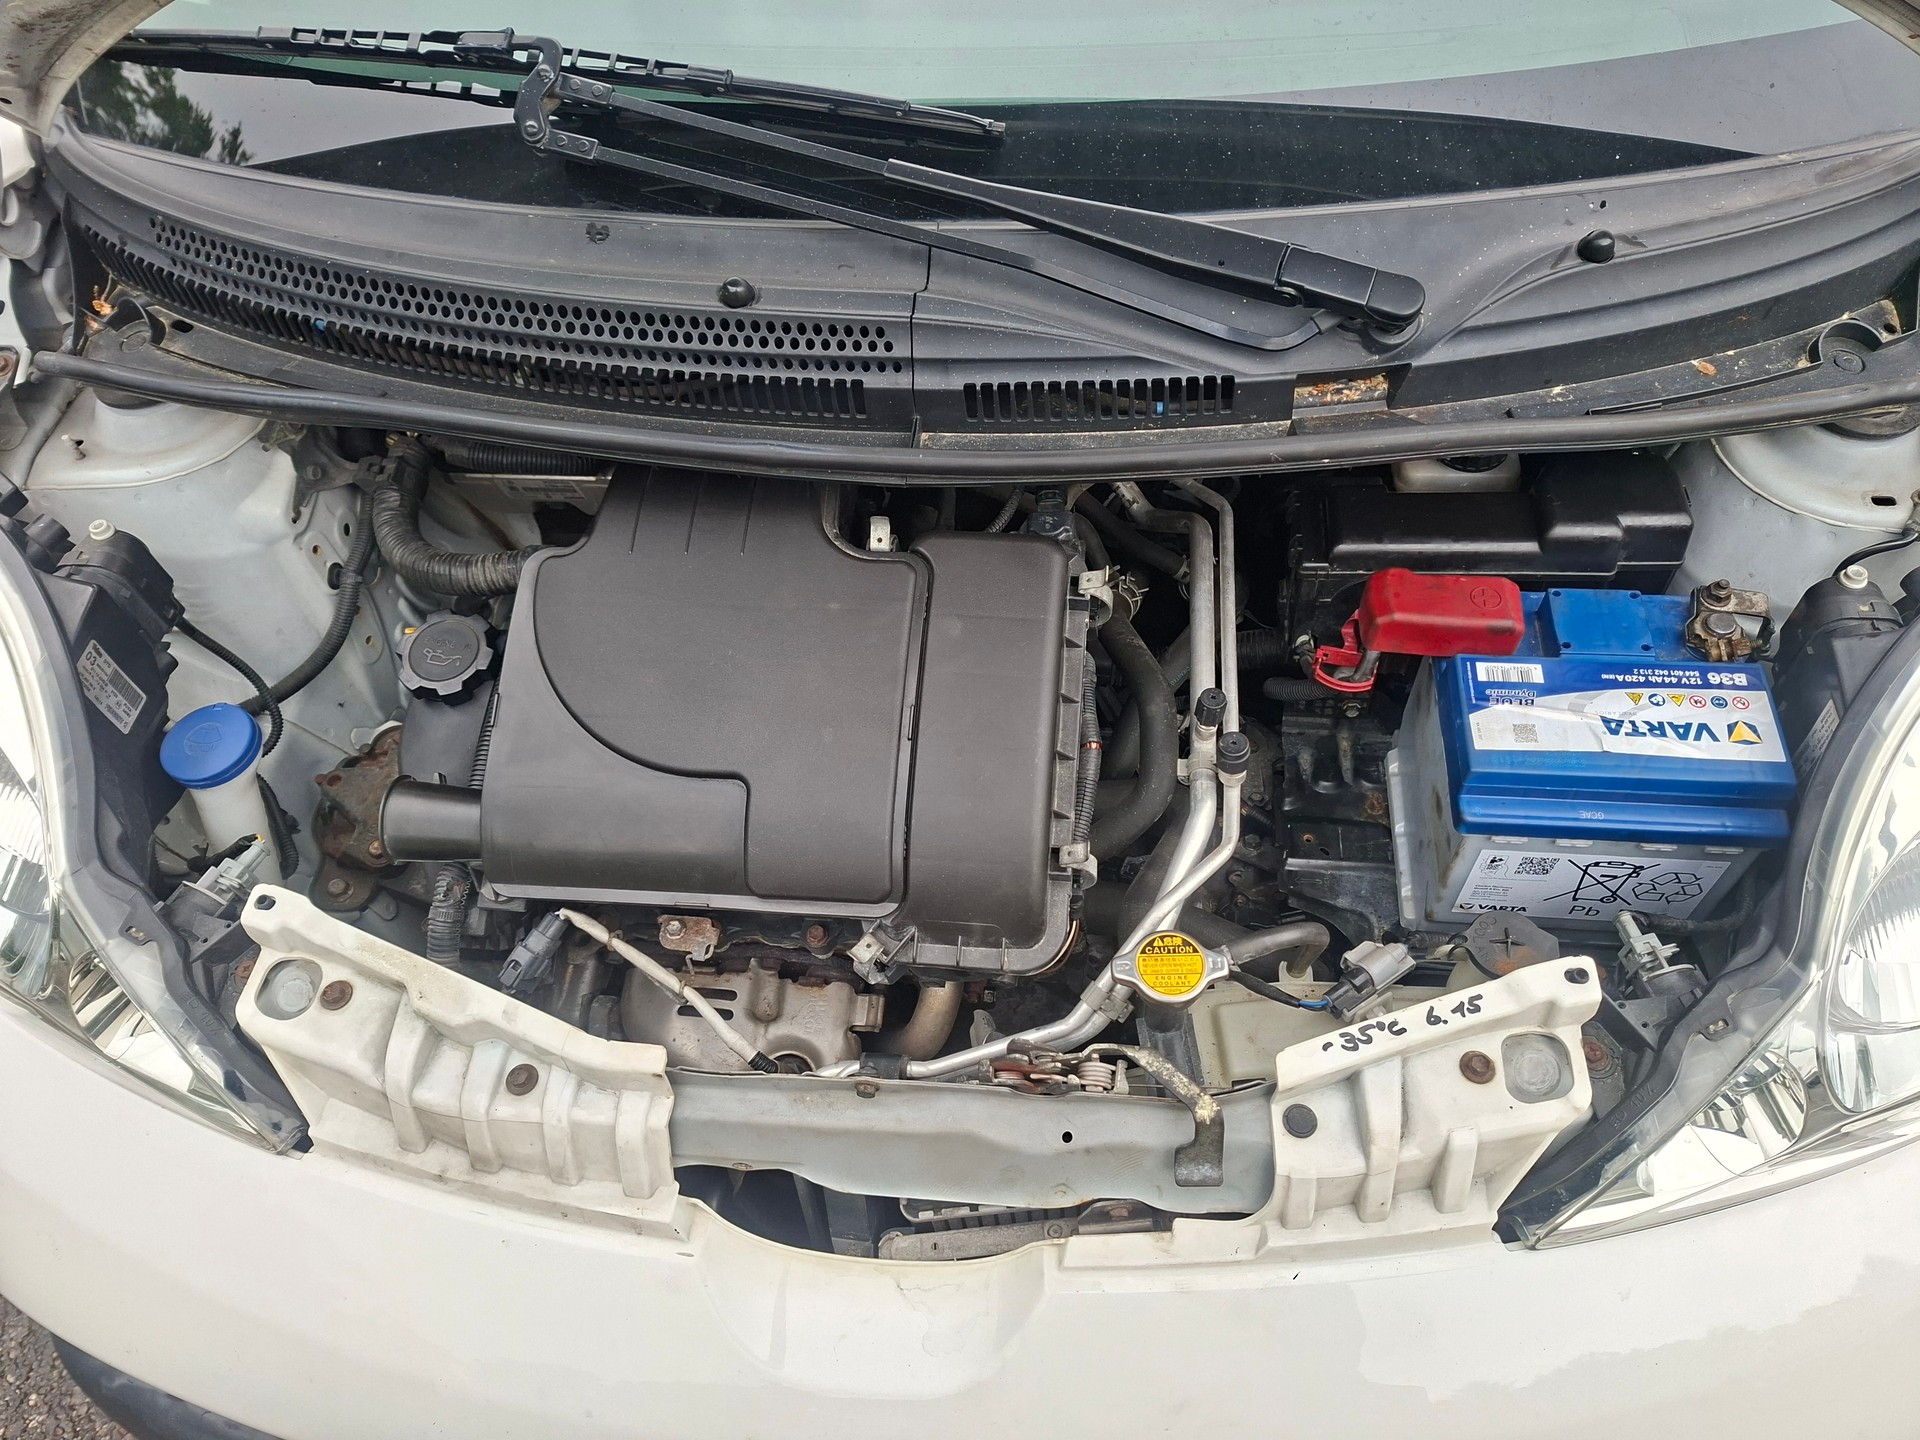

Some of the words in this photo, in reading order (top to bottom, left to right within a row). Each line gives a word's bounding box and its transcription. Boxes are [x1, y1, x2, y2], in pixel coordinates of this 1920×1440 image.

[85, 651, 97, 667] 03
[1644, 675, 1677, 684] 44Ah
[1681, 677, 1703, 685] 12V
[1707, 672, 1748, 686] B36
[1485, 689, 1537, 698] Dynamic
[1600, 716, 1721, 742] VARTA
[1478, 904, 1527, 912] VARTA
[1568, 905, 1600, 917] Pb
[1145, 946, 1193, 954] CAUTION
